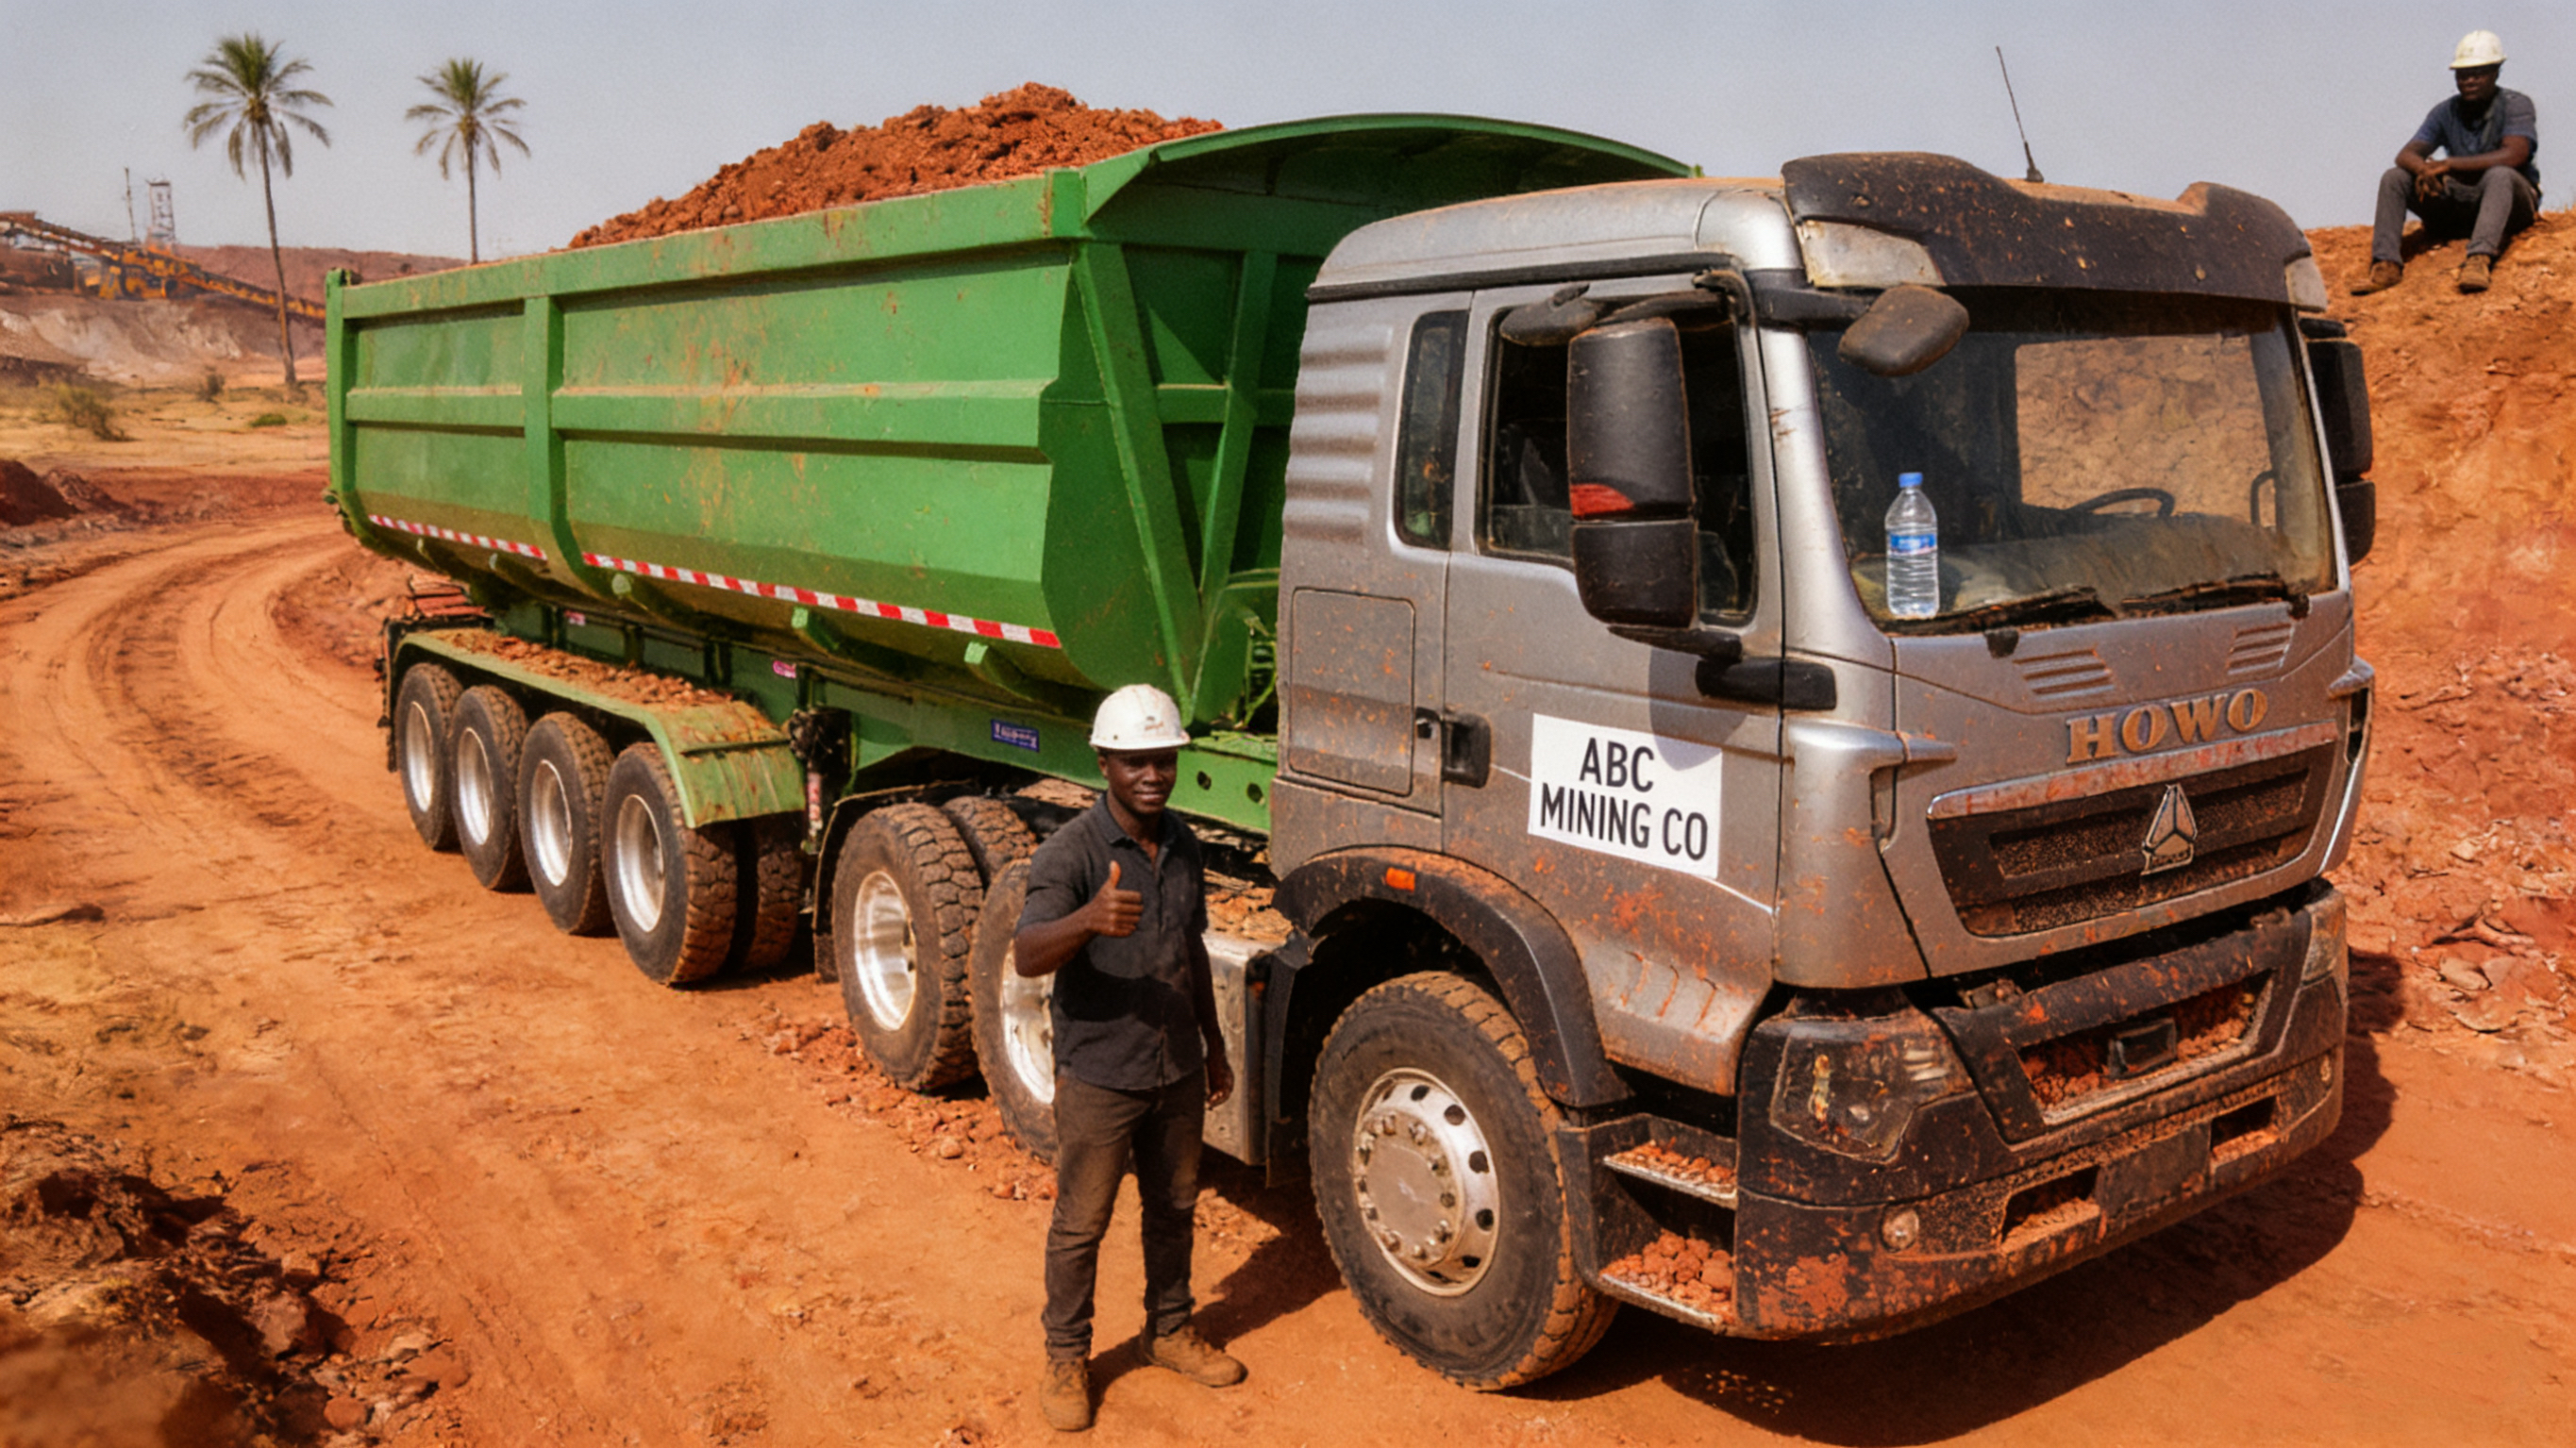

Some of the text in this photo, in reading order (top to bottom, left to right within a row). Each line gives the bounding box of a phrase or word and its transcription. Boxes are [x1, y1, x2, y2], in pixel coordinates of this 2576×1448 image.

[2066, 688, 2268, 764] HOWO
[1579, 737, 1654, 792] ABC
[1540, 782, 1708, 861] MINING CO
